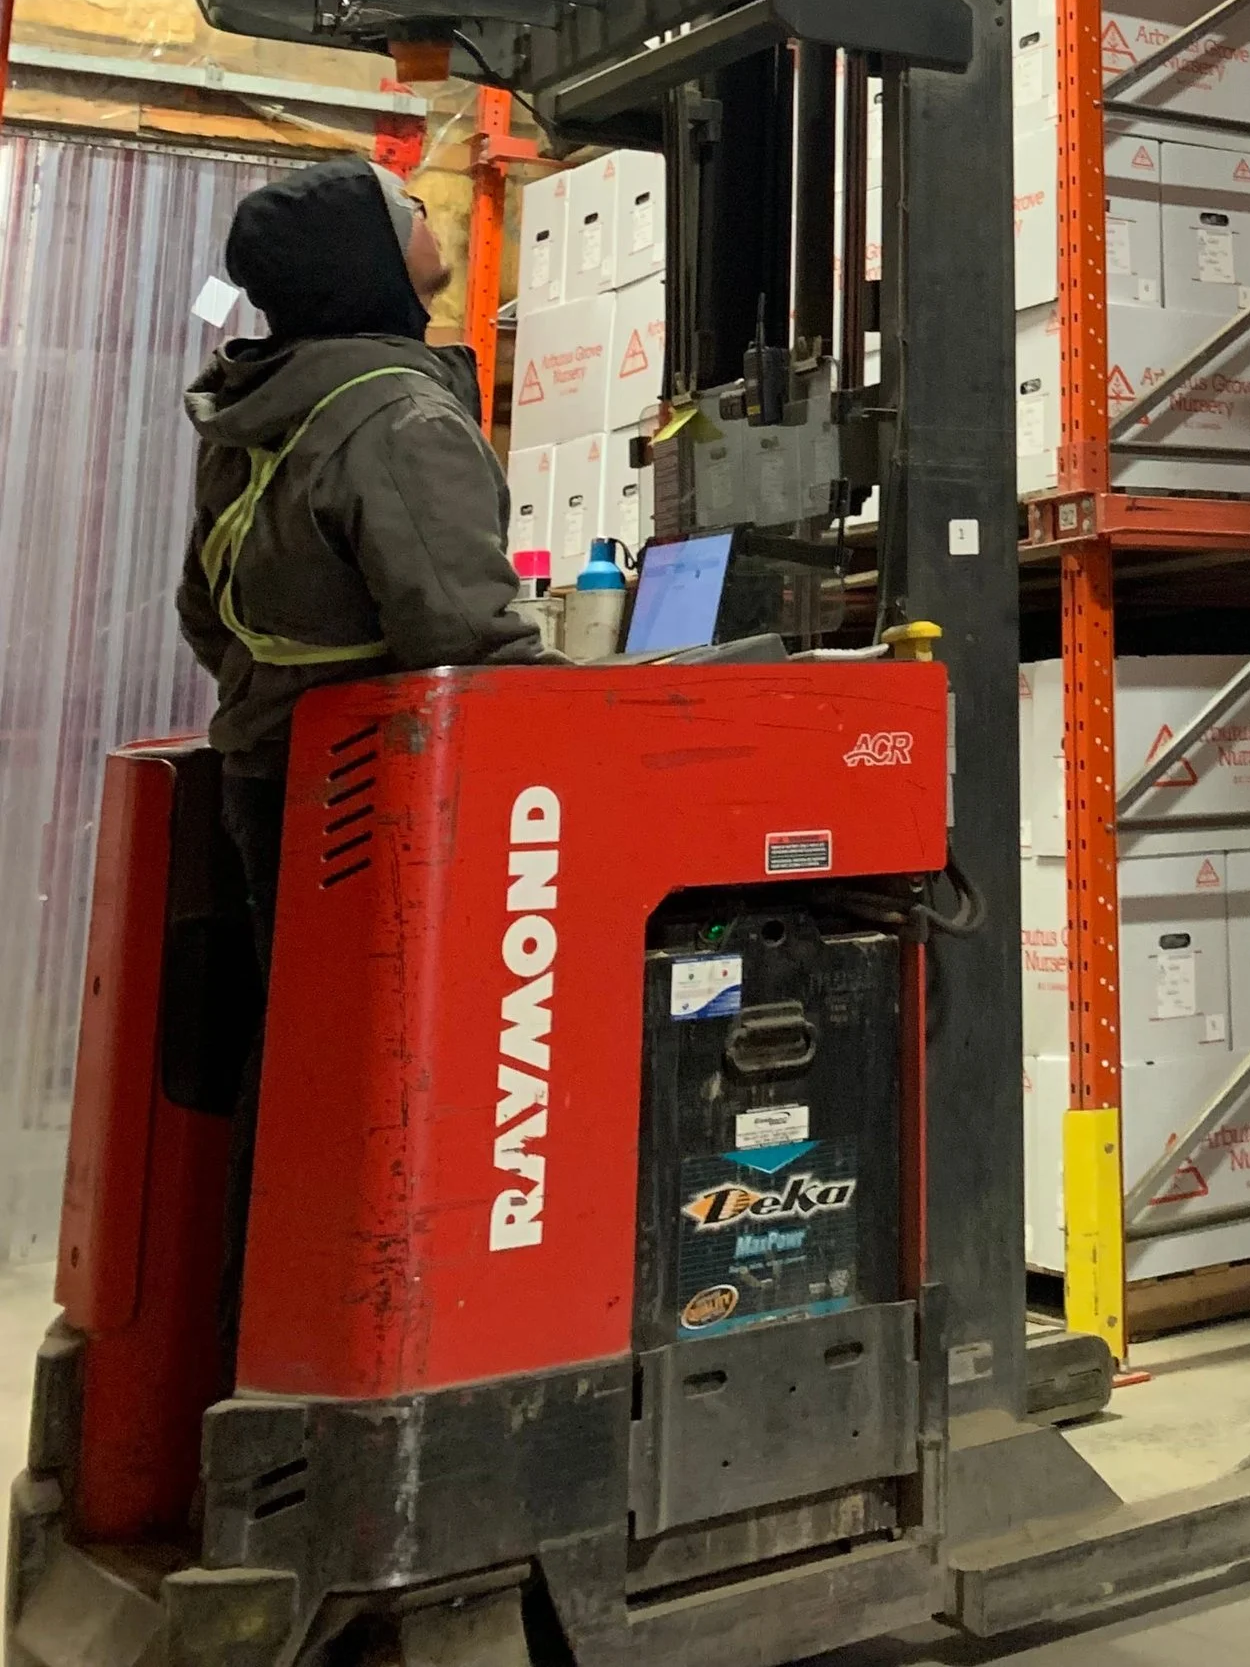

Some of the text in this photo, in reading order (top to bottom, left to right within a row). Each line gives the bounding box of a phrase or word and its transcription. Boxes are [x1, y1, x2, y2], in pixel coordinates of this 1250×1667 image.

[1204, 38, 1250, 63] Grove
[1168, 394, 1234, 421] Nursery
[843, 732, 913, 767] ACR
[489, 785, 562, 1252] RAYMOND
[700, 1176, 852, 1226] Deka
